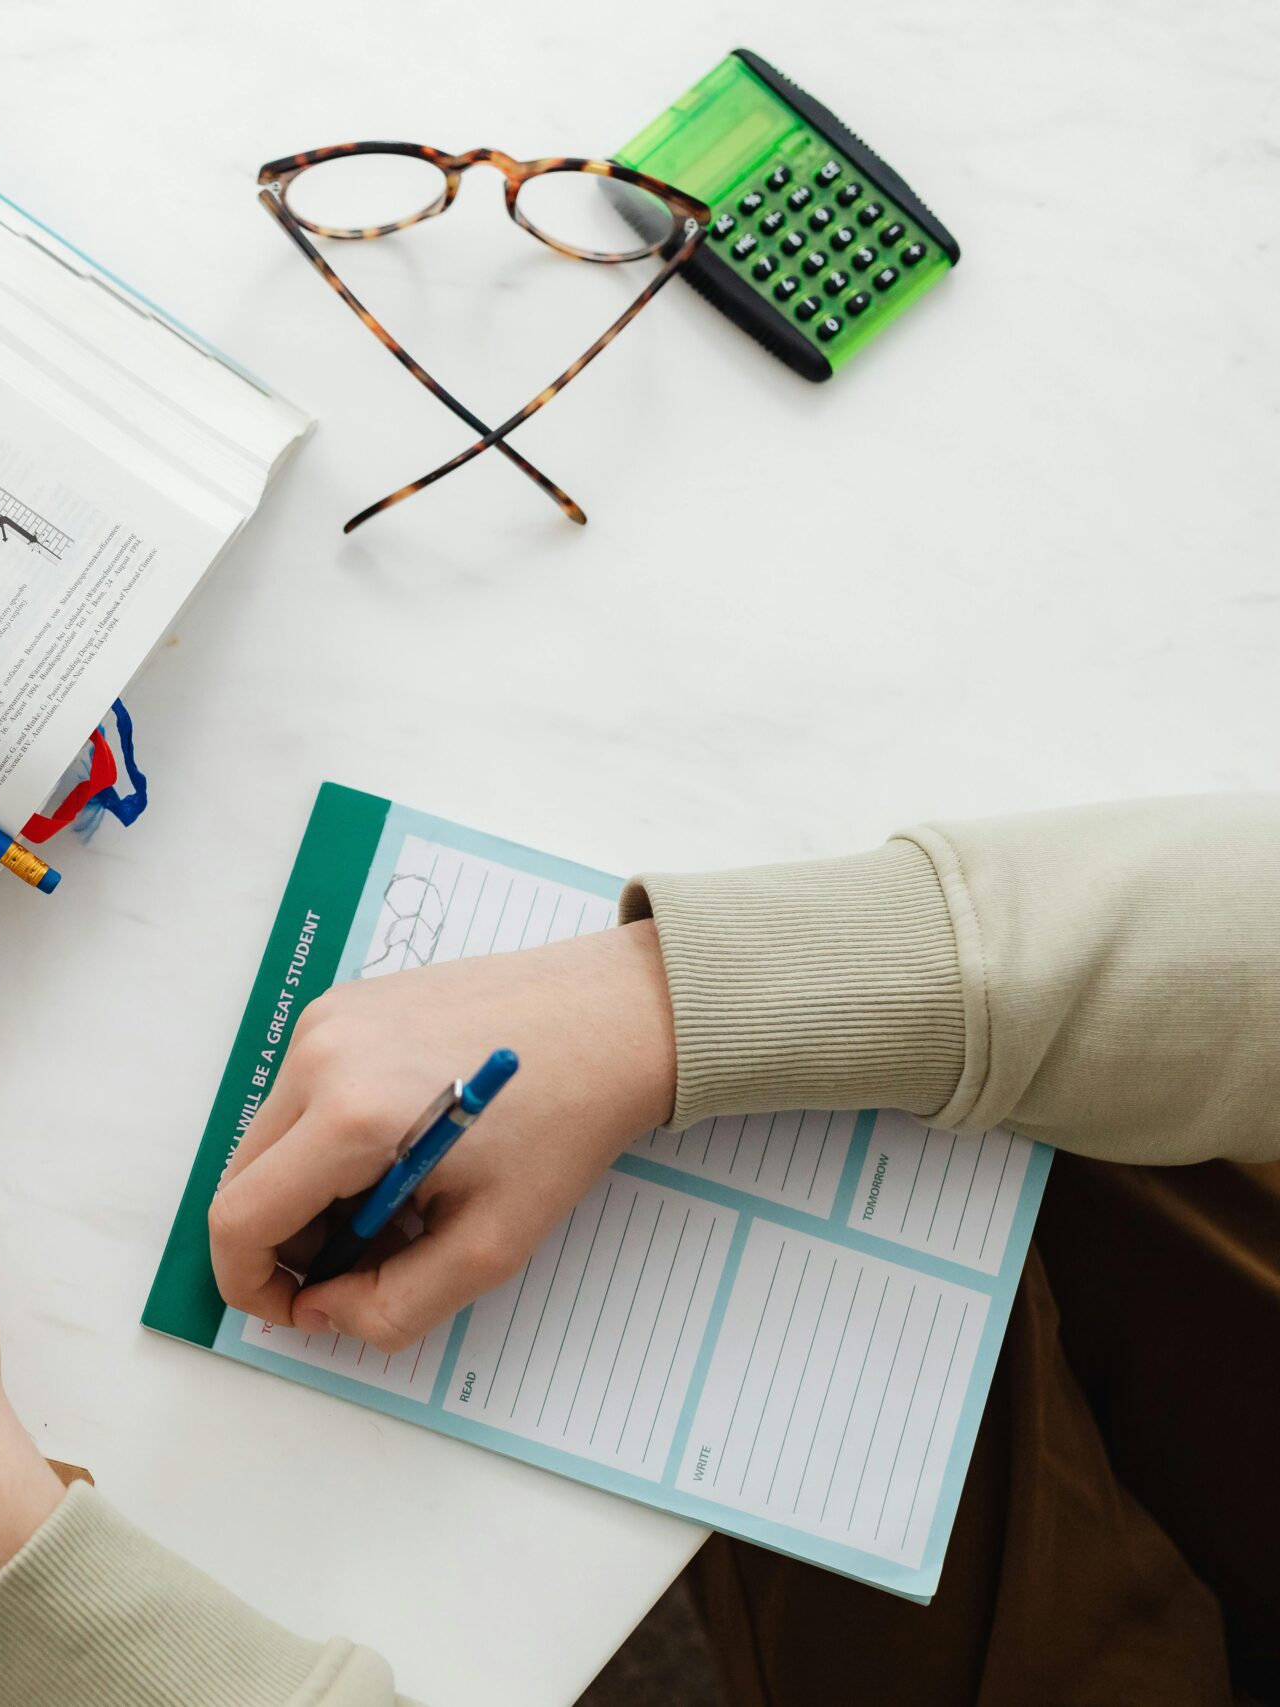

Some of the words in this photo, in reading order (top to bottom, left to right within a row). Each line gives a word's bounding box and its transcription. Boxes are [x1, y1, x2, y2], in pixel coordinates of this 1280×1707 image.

[759, 256, 772, 272] 7
[814, 208, 829, 222] 9
[781, 279, 796, 292] 4
[838, 228, 852, 242] 6
[830, 271, 846, 287] 2
[858, 247, 873, 262] 3
[825, 318, 839, 331] 0
[285, 909, 320, 986] STUDENT
[266, 988, 293, 1044] GREAT
[251, 1064, 270, 1087] BE
[260, 1049, 275, 1062] A
[236, 1092, 261, 1135] WILL
[863, 1152, 889, 1219] TOMORROW
[459, 1371, 476, 1402] READ
[692, 1445, 711, 1480] WRITE
